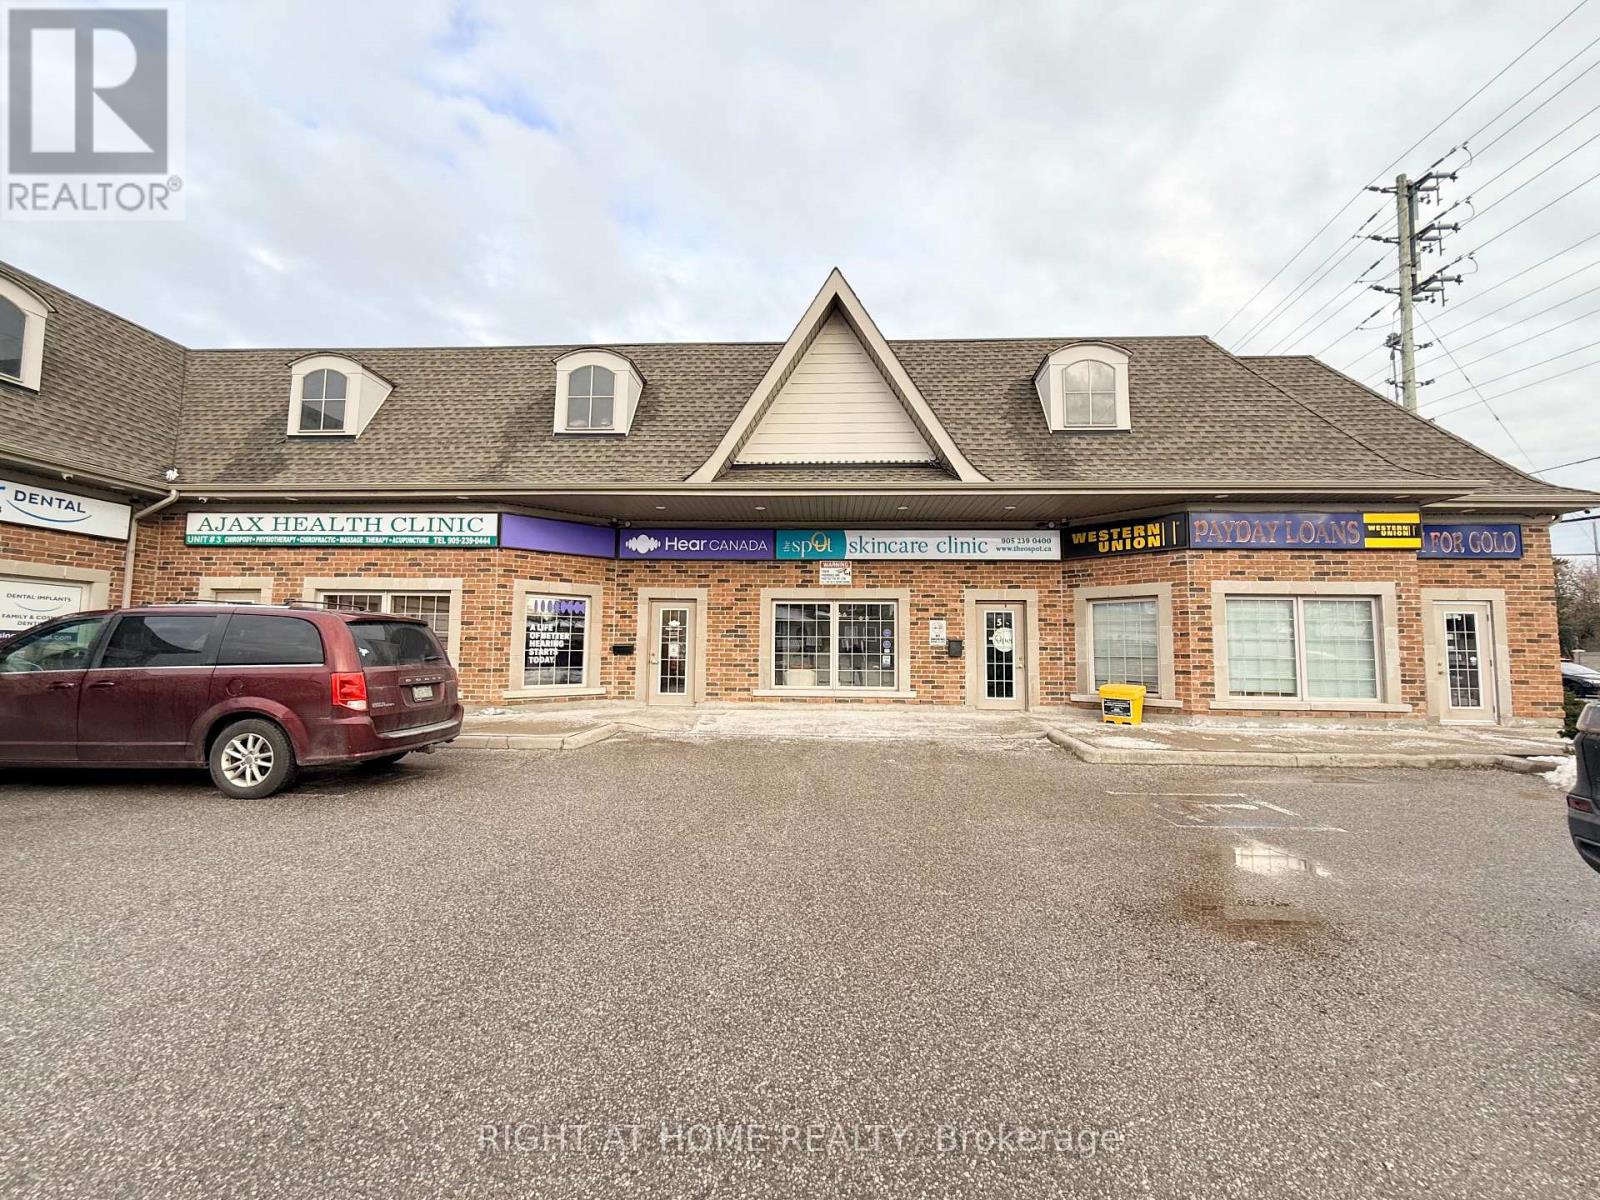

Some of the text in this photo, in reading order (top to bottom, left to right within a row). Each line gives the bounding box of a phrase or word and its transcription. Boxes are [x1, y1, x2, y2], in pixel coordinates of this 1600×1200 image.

[14, 490, 86, 513] DENTAL
[197, 516, 485, 533] AJAX HEALTH CLINIC
[1194, 519, 1361, 544] PAYDAY LOANS
[1072, 523, 1160, 544] WESTERN
[665, 536, 768, 551] Hear CANADA
[849, 536, 988, 554] skincare clinic
[1098, 535, 1161, 552] UNION
[1430, 532, 1465, 553] FOR
[1468, 532, 1517, 553] GOLD
[996, 618, 1002, 626] 5
[529, 648, 558, 656] STARTS
